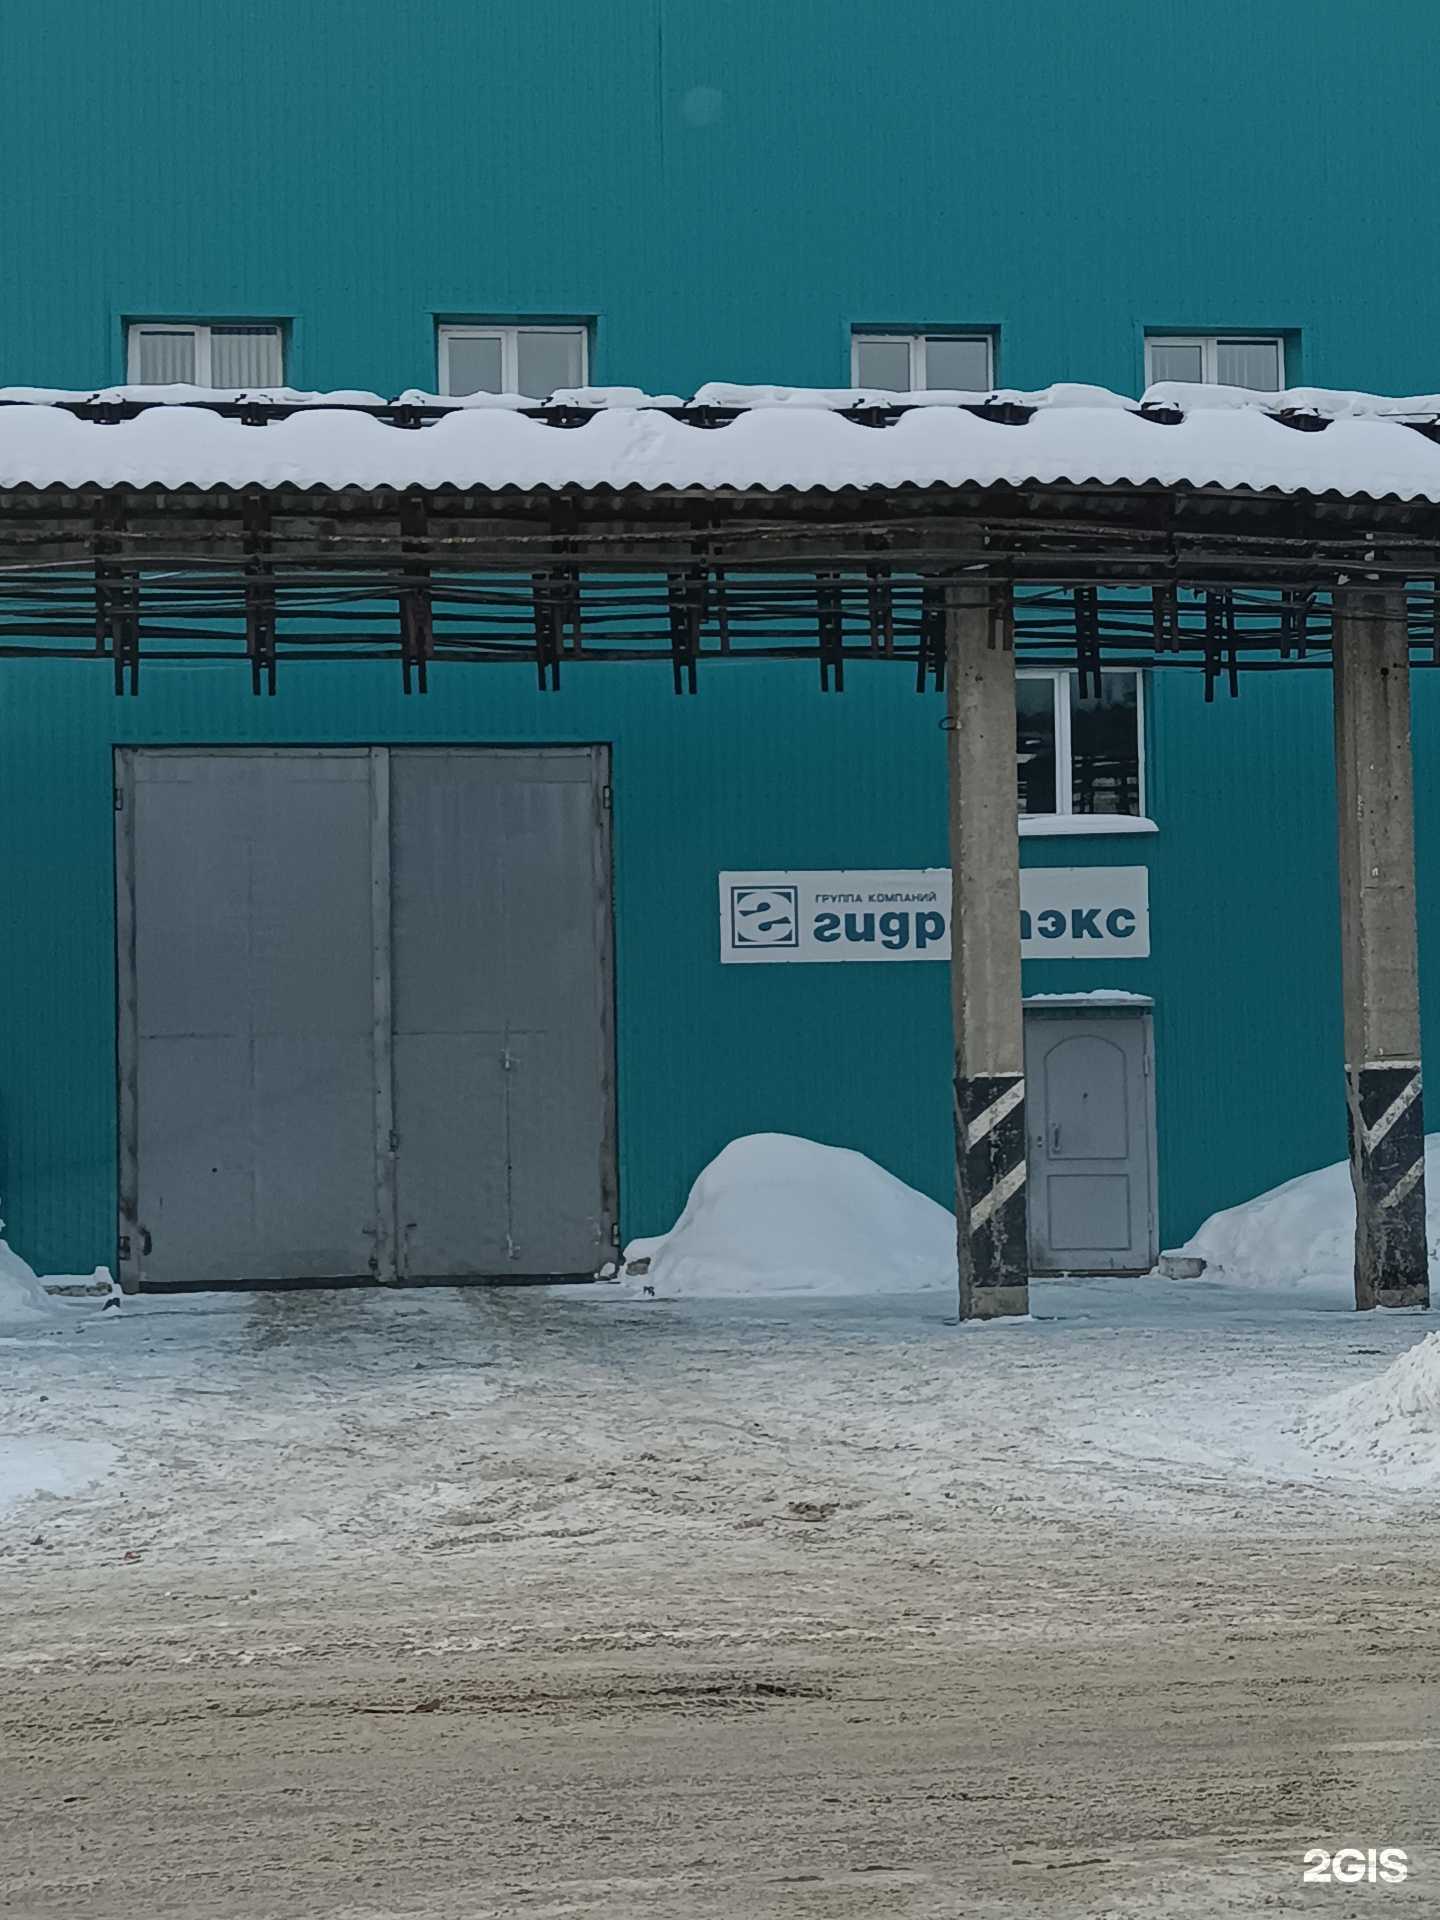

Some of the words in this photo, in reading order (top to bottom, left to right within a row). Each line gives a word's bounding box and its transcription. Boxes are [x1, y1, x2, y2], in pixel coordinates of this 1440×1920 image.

[815, 894, 862, 903] ГРУППА
[868, 891, 937, 903] КОМПАНИЙ
[813, 908, 1136, 950] гидрэкс
